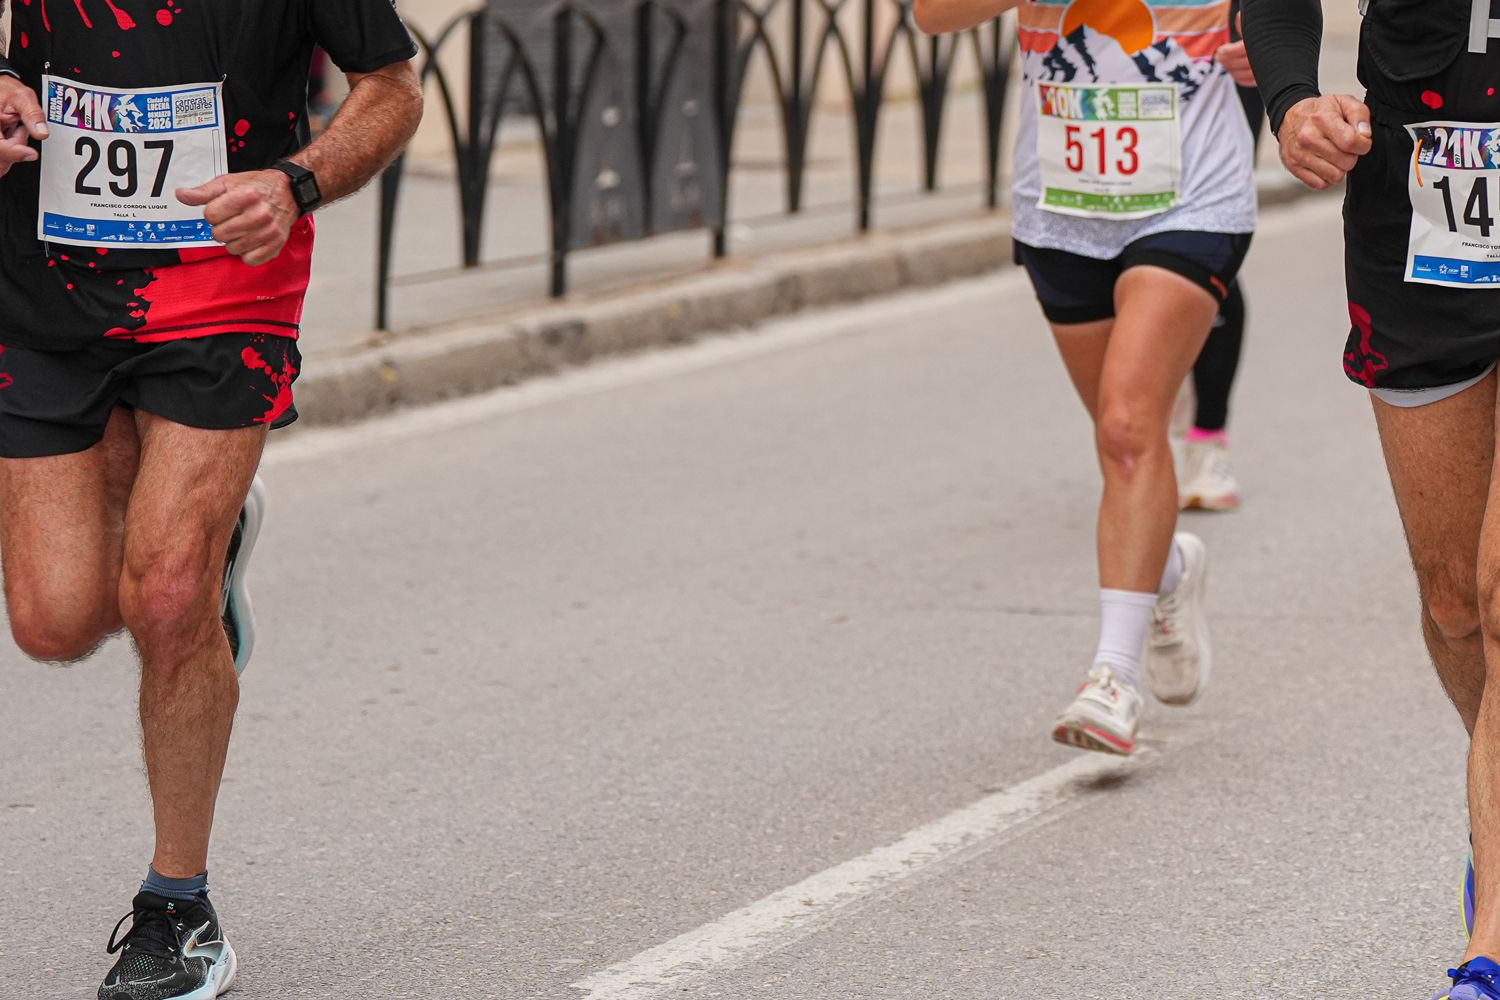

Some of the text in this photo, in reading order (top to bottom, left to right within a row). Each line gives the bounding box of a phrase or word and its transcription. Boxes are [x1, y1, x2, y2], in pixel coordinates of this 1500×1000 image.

[63, 87, 114, 131] 21K
[147, 102, 171, 111] LUCENA
[175, 97, 207, 107] carreras
[175, 102, 213, 114] populares
[1047, 86, 1084, 120] 10K
[148, 117, 172, 130] 2026
[1065, 125, 1139, 175] 513
[1433, 127, 1485, 168] 21K
[74, 136, 174, 197] 297
[1461, 241, 1490, 250] FRANCISCO
